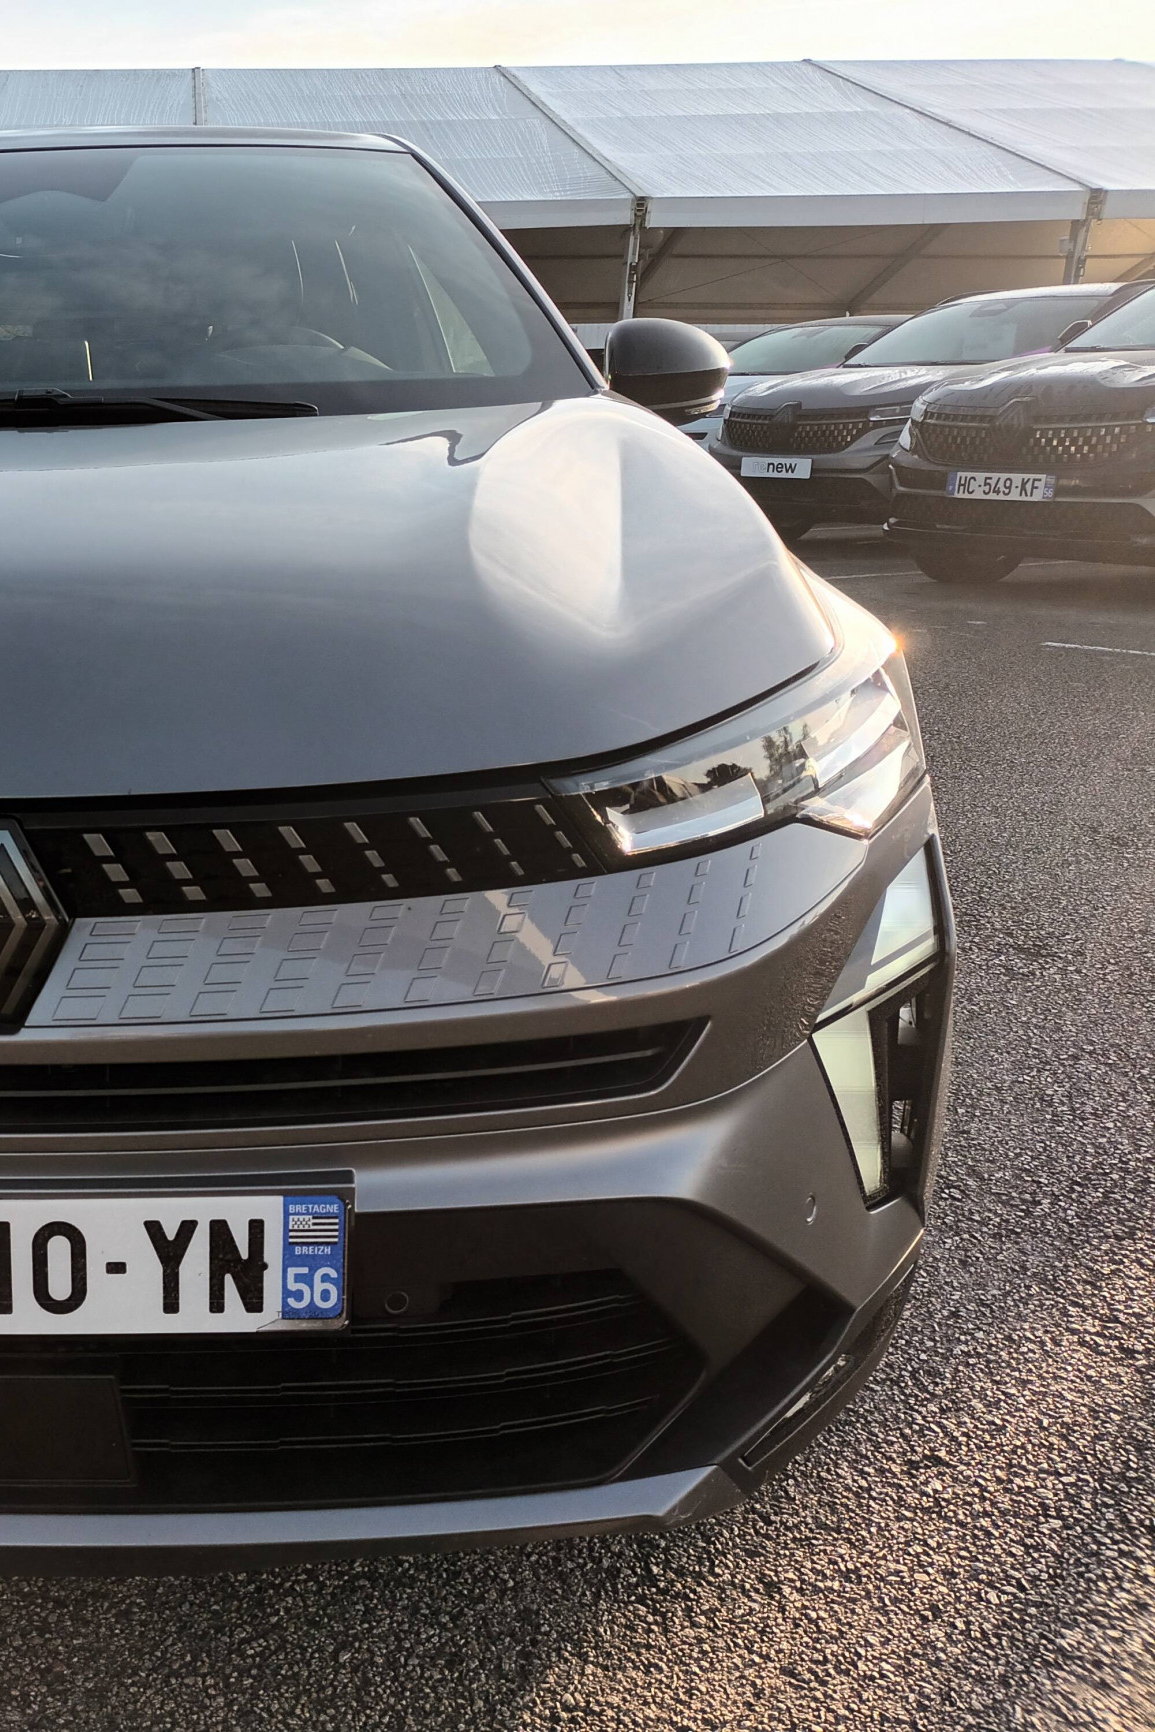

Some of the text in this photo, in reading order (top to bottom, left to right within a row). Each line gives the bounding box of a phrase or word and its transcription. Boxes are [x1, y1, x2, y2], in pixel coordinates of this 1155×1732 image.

[752, 461, 797, 474] renew
[957, 475, 1042, 497] HC-549-KF
[1043, 488, 1053, 498] 56
[288, 1204, 339, 1213] BRETAGNE
[294, 1246, 331, 1255] BREIZH
[287, 1266, 338, 1309] 56
